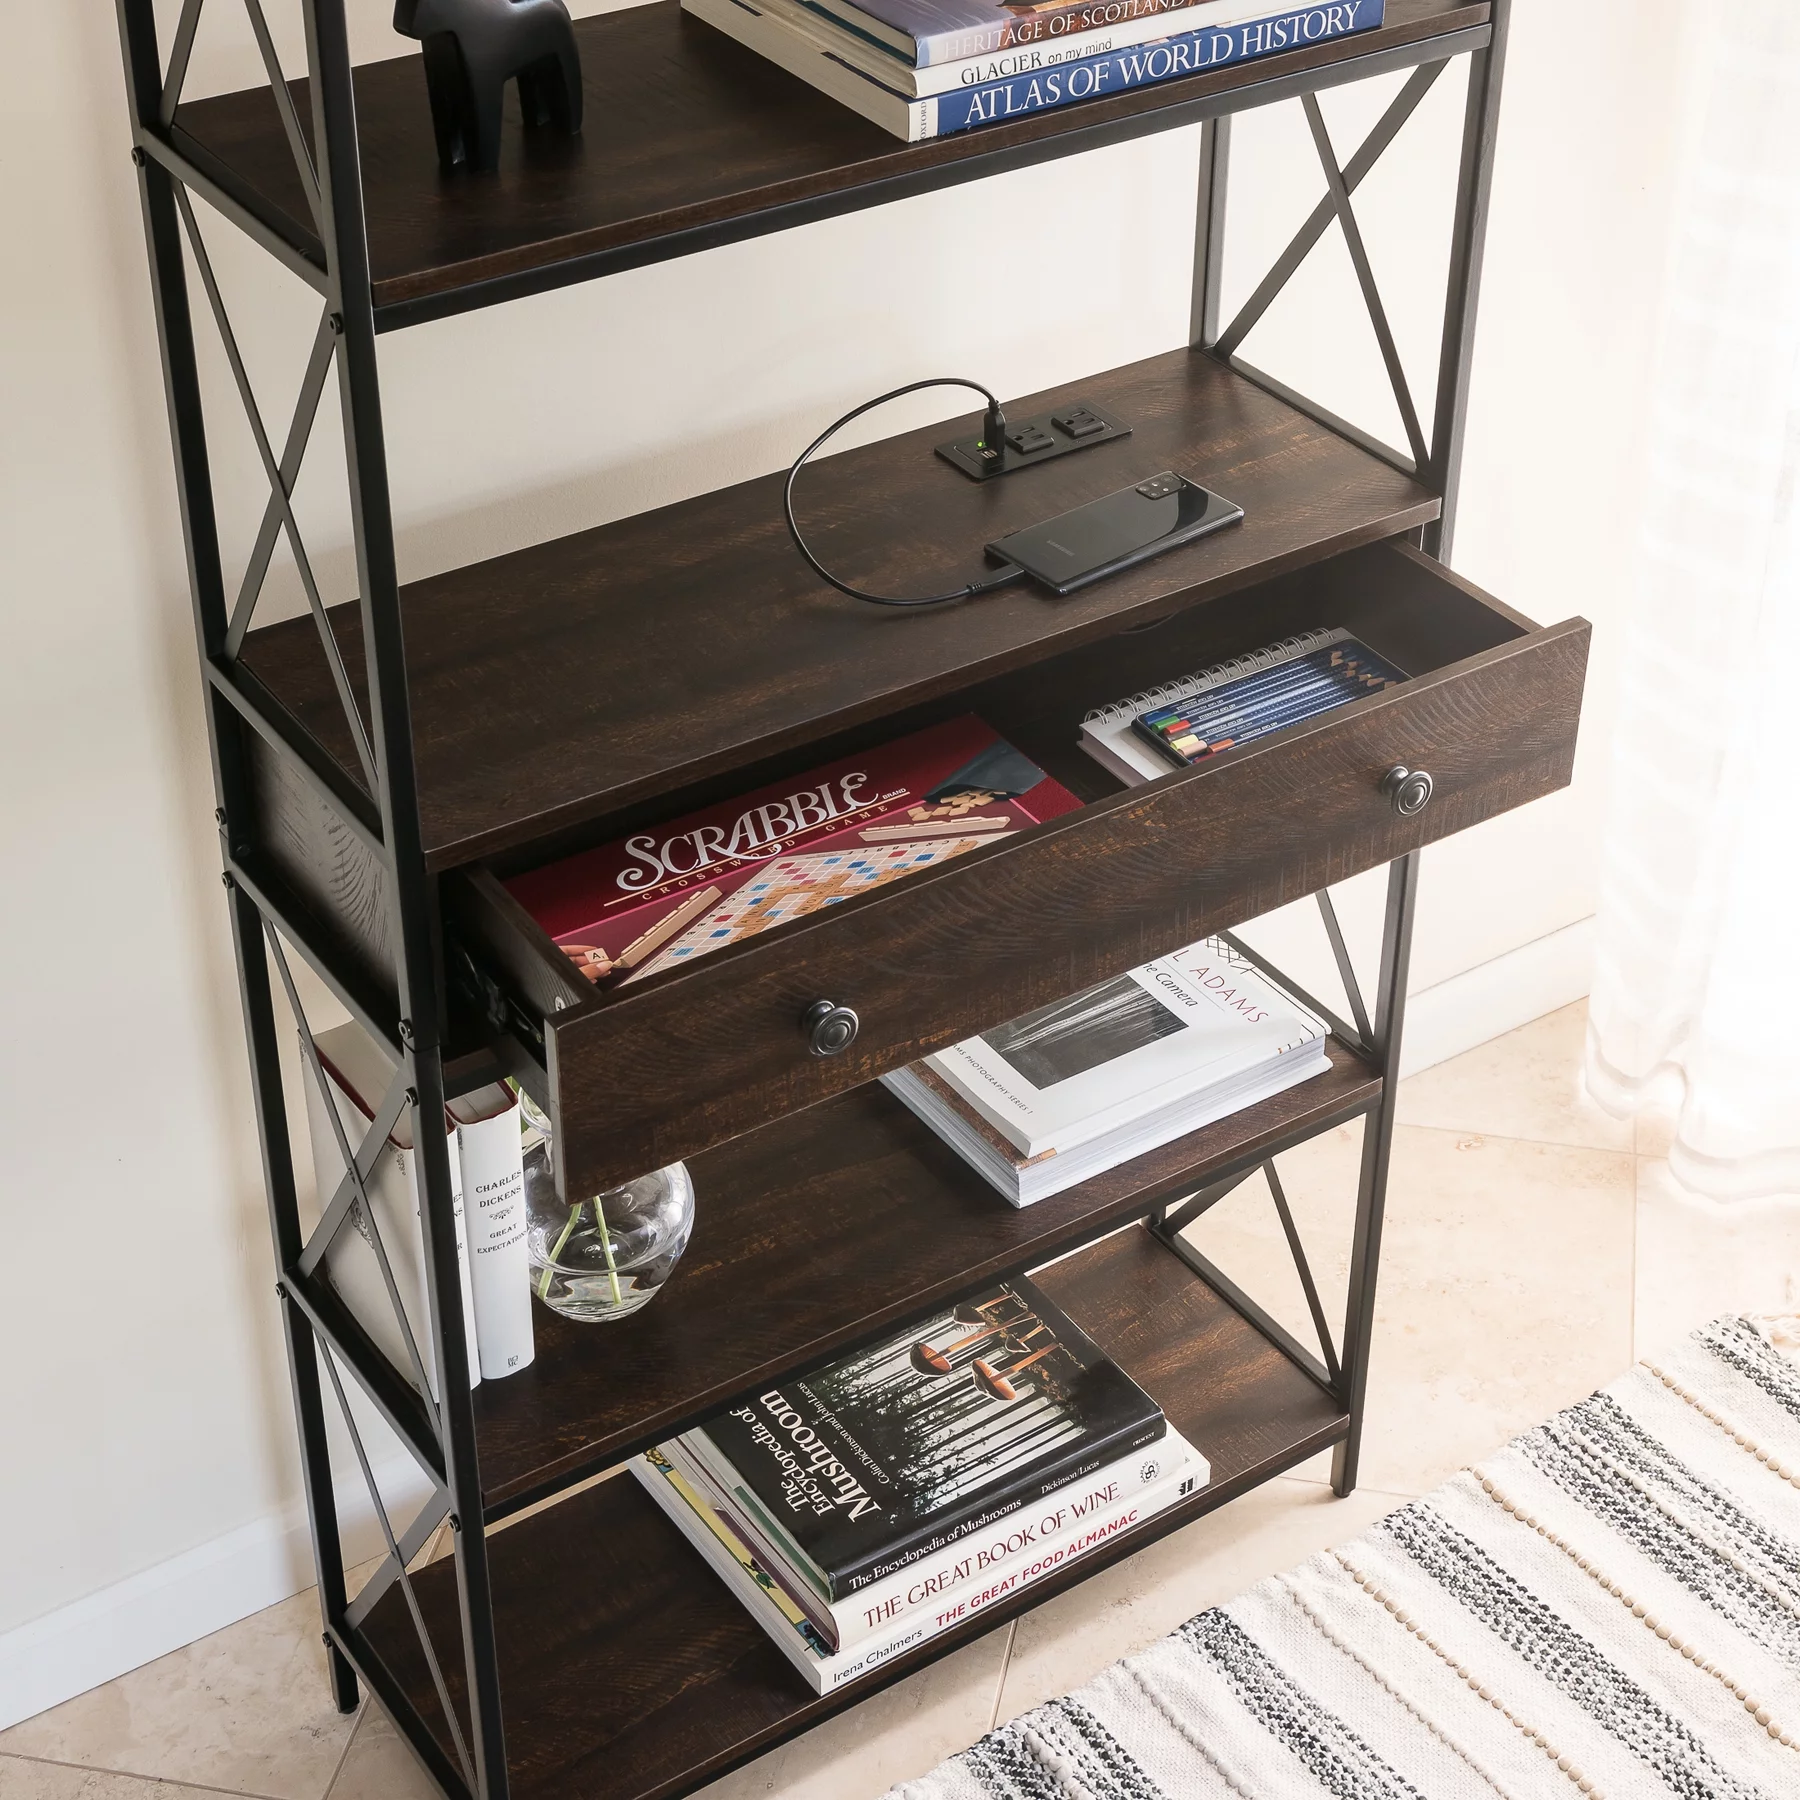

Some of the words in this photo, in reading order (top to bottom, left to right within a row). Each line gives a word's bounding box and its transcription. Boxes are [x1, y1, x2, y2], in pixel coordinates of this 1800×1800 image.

[944, 20, 1043, 60] HERITAGE
[1049, 13, 1076, 35] OF
[1081, 0, 1186, 28] SCOTLAND
[961, 51, 1042, 85] GLACIER
[1048, 53, 1063, 65] on
[1065, 48, 1082, 61] my
[1085, 38, 1112, 55] mind
[964, 73, 1062, 124] ATLAS
[1068, 62, 1110, 97] OF
[1117, 33, 1234, 84] WORLD
[1240, 1, 1362, 56] HISTORY
[616, 772, 879, 891] SCRABBLE
[882, 788, 907, 800] BRAND
[642, 839, 796, 900] CROSSWORD
[825, 805, 888, 832] GAME
[1155, 972, 1199, 1007] Camera
[1189, 967, 1269, 1022] ADAMS
[965, 1055, 1010, 1095] PHOTOGRAPHY
[1008, 1095, 1029, 1111] SERIES
[475, 1170, 521, 1193] CHARLES
[479, 1185, 521, 1208] DICKENS
[490, 1223, 517, 1239] GREAT
[729, 1406, 756, 1423] of
[797, 1382, 818, 1404] Lucas
[814, 1401, 835, 1420] John
[826, 1417, 844, 1430] and
[752, 1422, 836, 1517] Encyclopedia
[760, 1390, 882, 1523] Mushroom
[840, 1429, 873, 1466] Dickinson
[780, 1479, 810, 1512] The
[870, 1463, 890, 1484] Colin
[849, 1573, 873, 1590] The
[874, 1537, 946, 1579] Encyclopedia
[947, 1527, 962, 1543] of
[960, 1499, 1022, 1536] Mushrooms
[1041, 1460, 1100, 1494] Dickinson/Lucas
[864, 1595, 904, 1628] THE
[907, 1558, 973, 1605] GREAT
[977, 1525, 1037, 1571] BOOK
[1040, 1509, 1067, 1536] OF
[1071, 1482, 1121, 1519] WINE
[833, 1662, 864, 1683] Irena
[866, 1629, 923, 1664] Chalmers
[936, 1604, 966, 1627] THE
[970, 1574, 1018, 1608] GREAT
[1022, 1551, 1064, 1581] FOOD
[1067, 1509, 1138, 1556] ALMANAC
